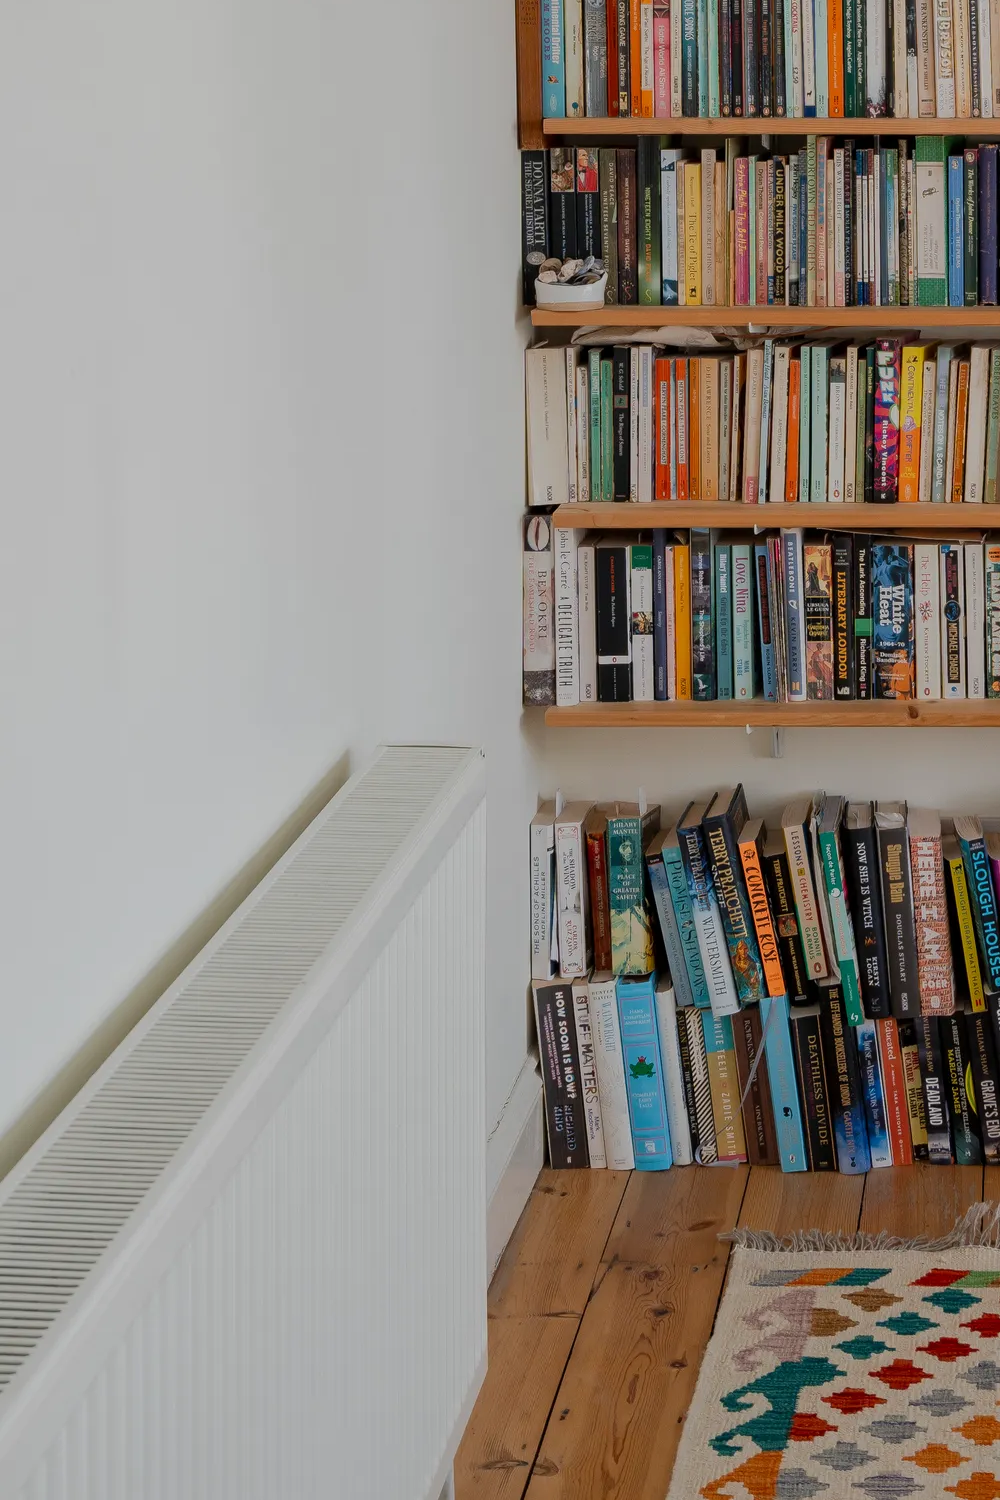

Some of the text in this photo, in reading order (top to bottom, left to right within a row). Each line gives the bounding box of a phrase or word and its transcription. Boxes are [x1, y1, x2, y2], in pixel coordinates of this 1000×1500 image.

[552, 37, 560, 63] Drifter
[685, 17, 694, 40] SPRINGS
[921, 3, 929, 53] FRANKENSTEIN
[526, 212, 534, 245] HISTORY
[532, 161, 545, 245] DONNA TARTT
[776, 169, 784, 272] UNDER MILK WOOD
[992, 389, 1000, 419] GRAVES
[837, 572, 847, 679] LITERARY LONDON
[879, 586, 892, 626] Heat
[892, 584, 905, 634] White
[948, 623, 958, 680] MICHAEL CHABON
[856, 842, 873, 928] NOW SHE IS WITCH
[886, 844, 906, 982] Shuggie Bain DOUGLAS STUART
[917, 841, 942, 960] HERE I AM
[972, 851, 993, 916] SLOUGH
[555, 992, 576, 1099] HOW SOON IS NOW?
[807, 1035, 823, 1100] DEATHLESS
[816, 1104, 828, 1145] DIVIDE
